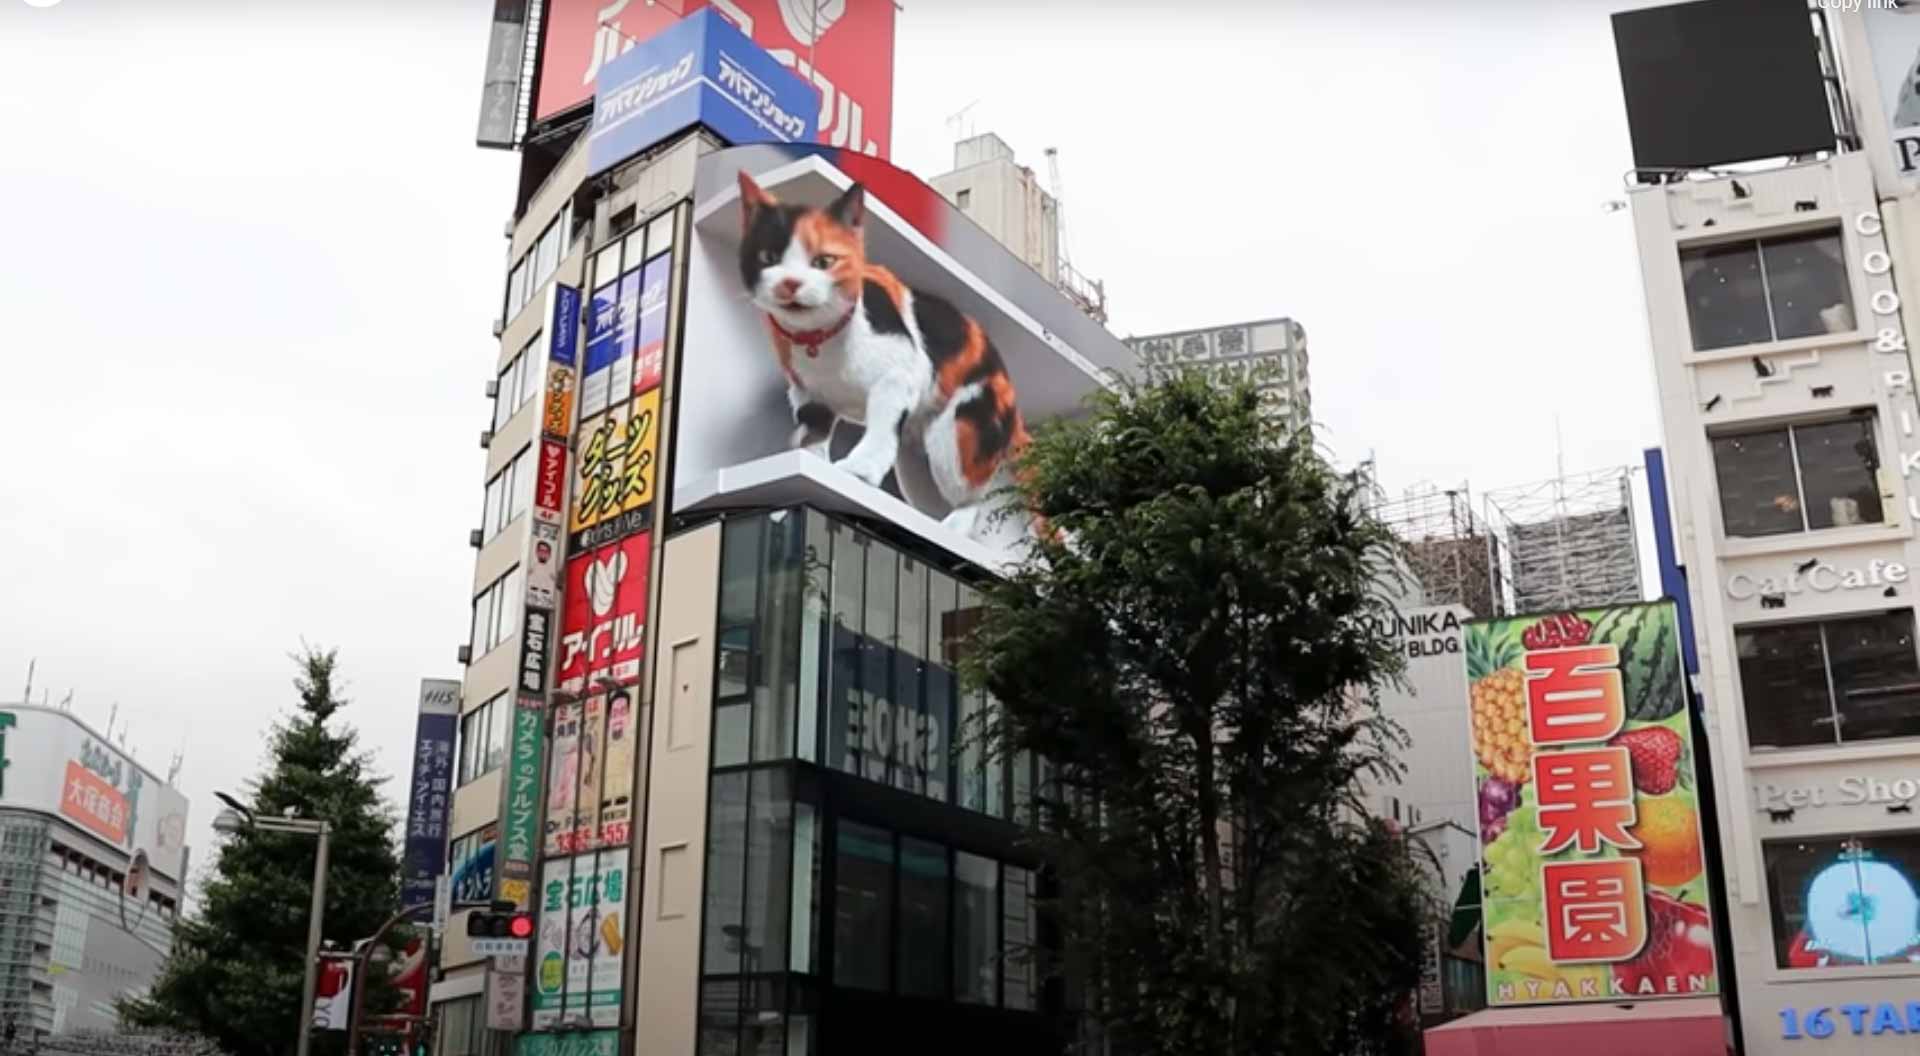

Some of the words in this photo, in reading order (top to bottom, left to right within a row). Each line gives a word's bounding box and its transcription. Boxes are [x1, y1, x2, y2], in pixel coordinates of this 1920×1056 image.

[581, 409, 652, 478] ダーツ
[577, 451, 651, 523] グッズ
[1807, 558, 1908, 593] Cafe
[1524, 643, 1650, 965] 百果園
[1839, 774, 1920, 806] Sho
[1499, 974, 1709, 999] HYAKKAEN
[1778, 1006, 1836, 1040] 16
